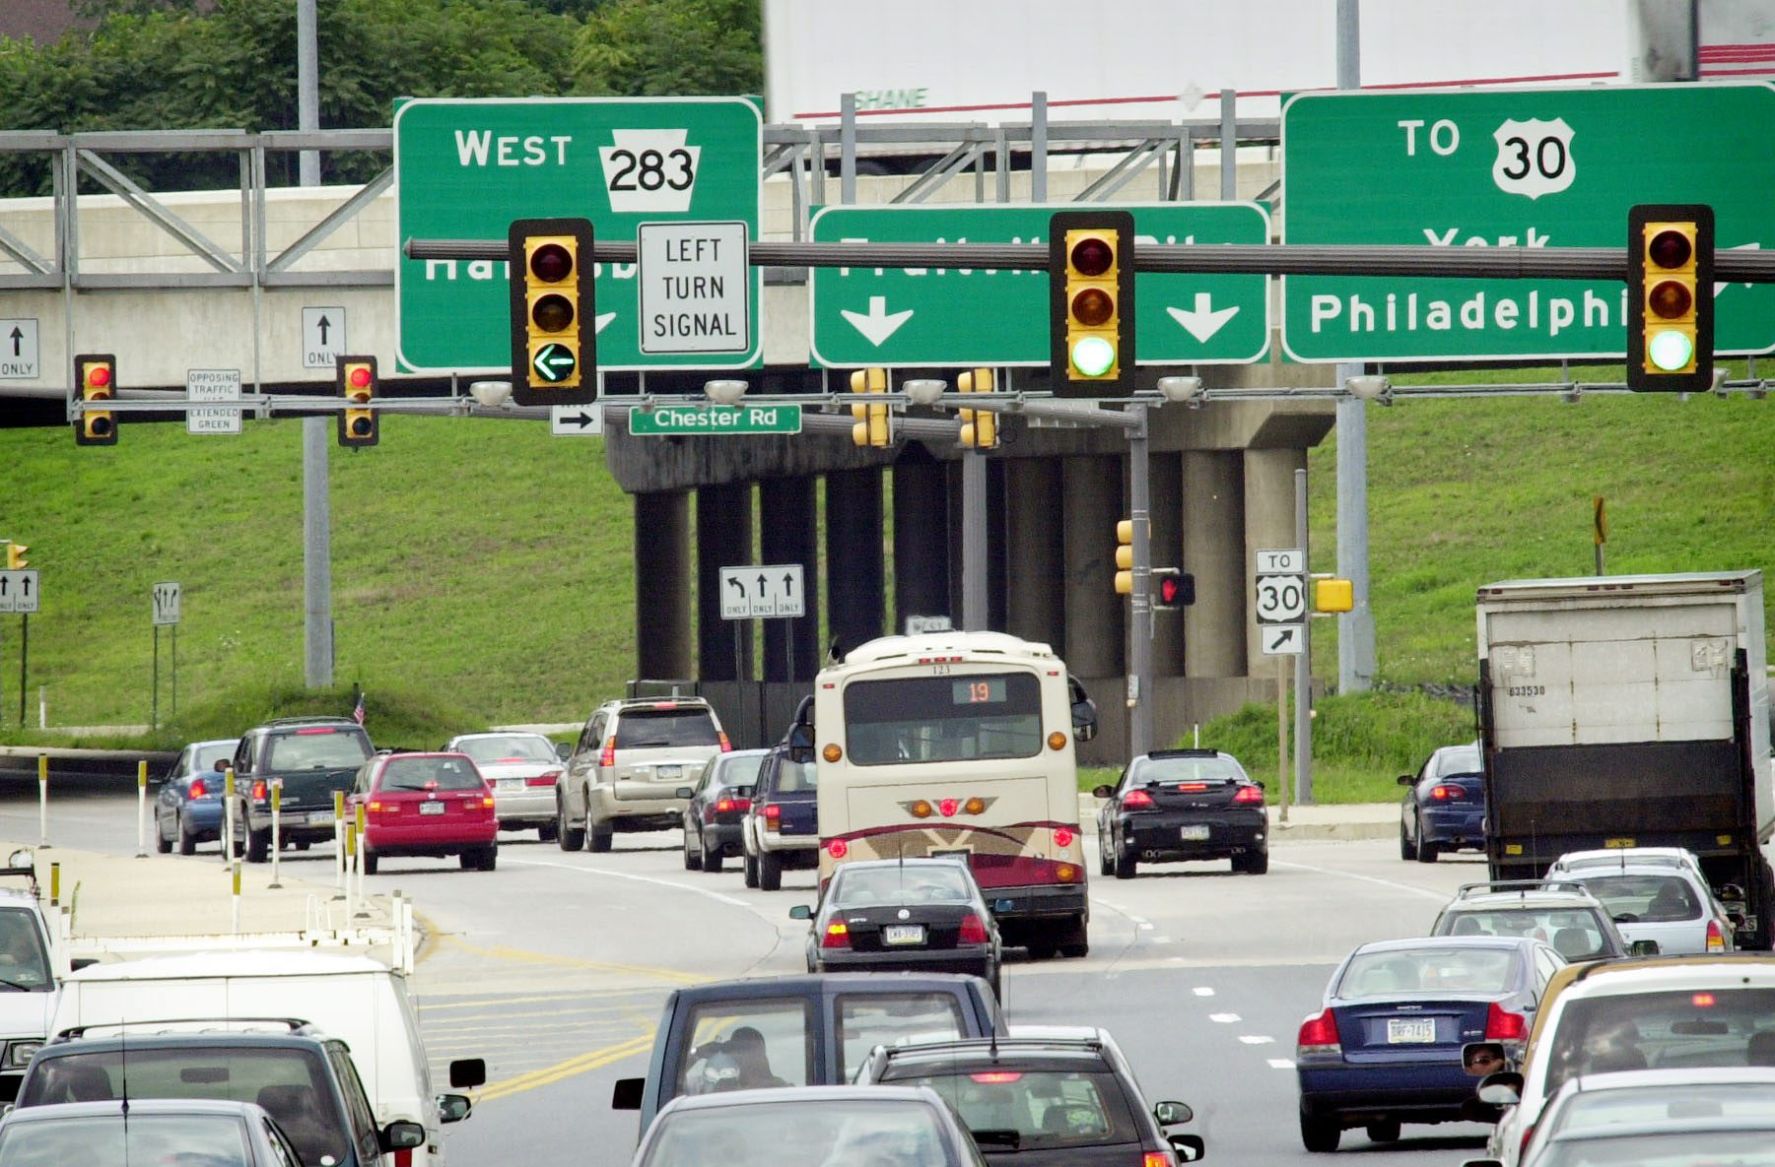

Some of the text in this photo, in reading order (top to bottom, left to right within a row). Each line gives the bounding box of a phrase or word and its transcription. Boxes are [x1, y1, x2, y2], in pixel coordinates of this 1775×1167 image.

[1398, 119, 1460, 156] TO
[1502, 136, 1566, 180] 30
[609, 149, 694, 191] 283
[666, 239, 722, 262] LEFT
[663, 276, 724, 300] TURN
[1311, 289, 1628, 336] Philadelphi
[654, 314, 737, 337] SIGNAL
[1, 363, 33, 375] ONLY
[190, 373, 239, 382] OPPOSING
[194, 385, 233, 393] TRAFFIC
[198, 420, 230, 429] GREEN
[654, 408, 778, 427] Chester Rd
[1268, 554, 1290, 568] TO
[1262, 585, 1300, 611] 30
[727, 606, 747, 614] ONLY
[753, 605, 772, 613] ONLY
[779, 604, 799, 612] ONLY
[970, 682, 990, 702] 19
